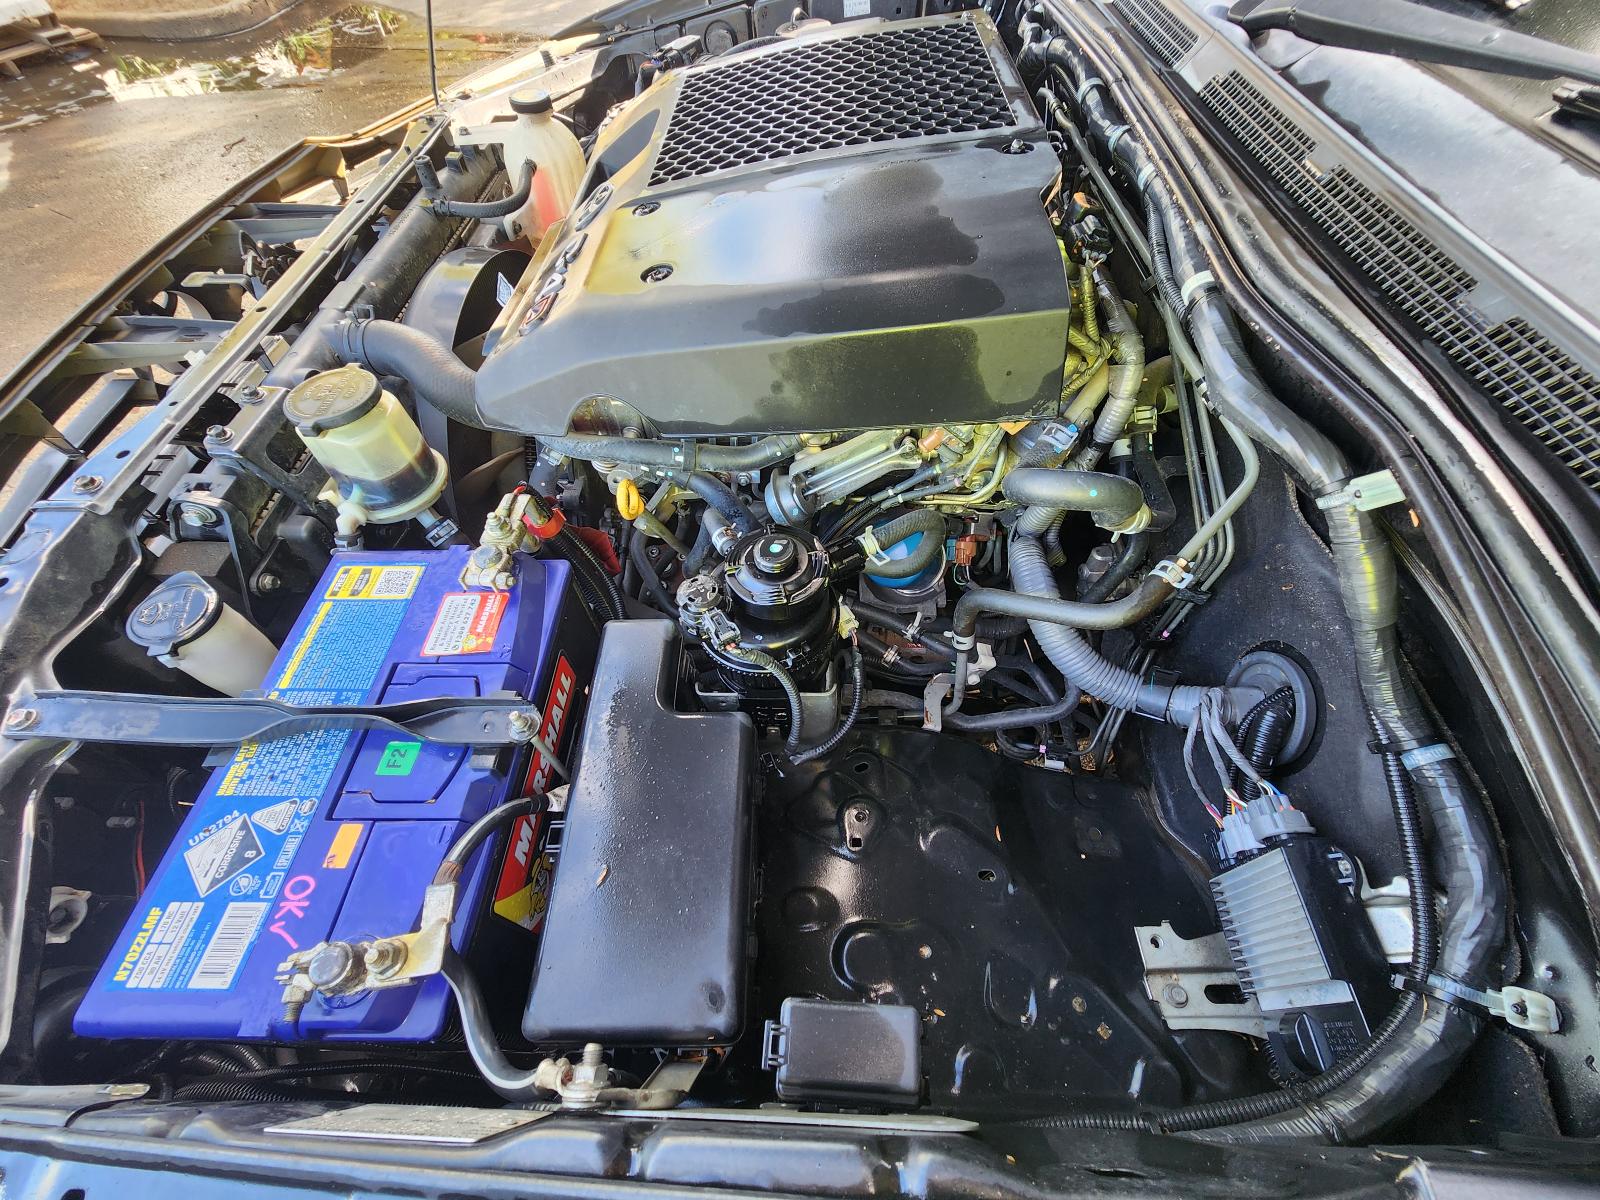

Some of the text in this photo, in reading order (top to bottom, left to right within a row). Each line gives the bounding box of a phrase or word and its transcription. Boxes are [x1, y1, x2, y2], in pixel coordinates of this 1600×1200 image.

[385, 748, 408, 769] F2
[188, 809, 240, 847] UN2794
[214, 829, 246, 879] CORROSIVE
[244, 850, 257, 858] 8
[274, 875, 316, 919] OK
[113, 907, 163, 981] N70ZZLMF
